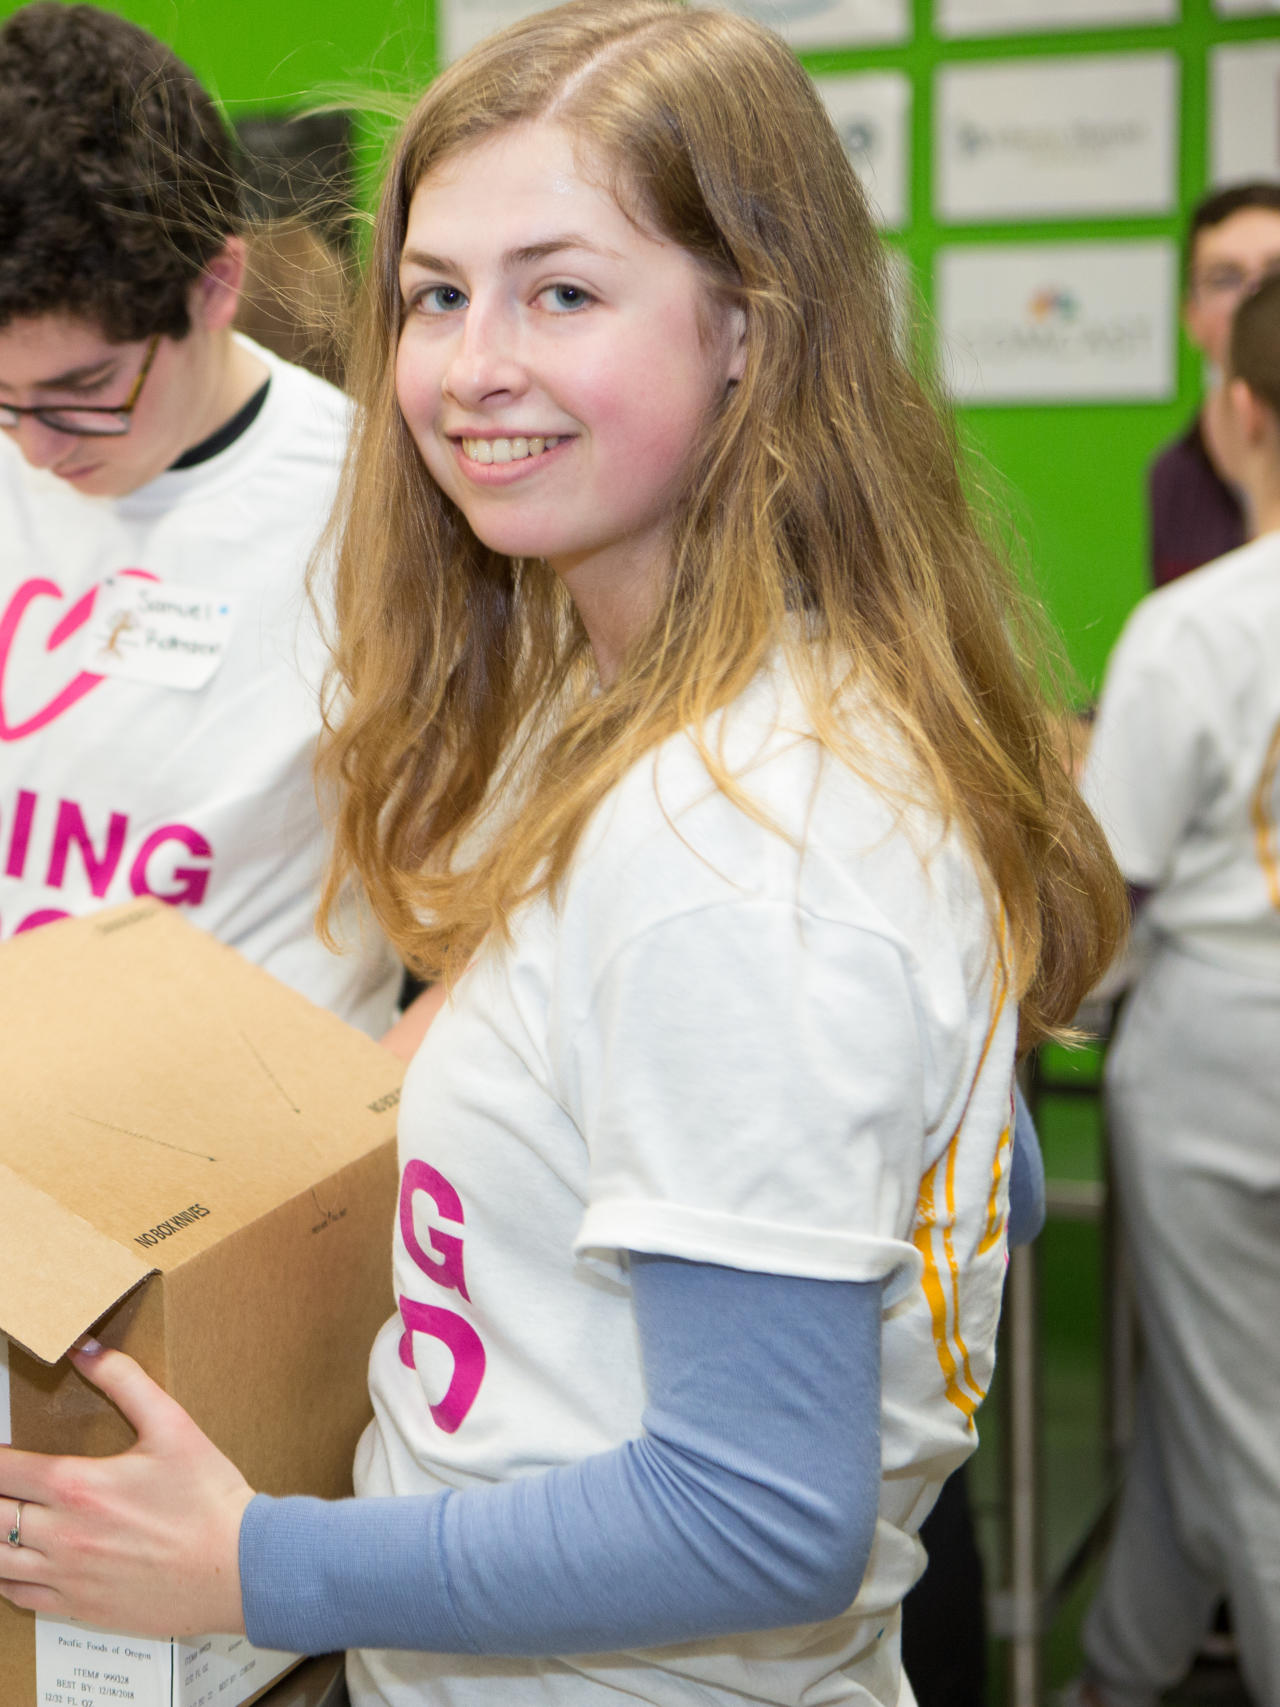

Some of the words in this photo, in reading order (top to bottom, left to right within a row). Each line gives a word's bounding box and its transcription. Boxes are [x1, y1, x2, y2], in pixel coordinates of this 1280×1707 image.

[133, 1233, 158, 1249] NO
[149, 1220, 180, 1240] BOX
[171, 1203, 210, 1229] KNIVES
[58, 1636, 82, 1648] Pacific
[86, 1641, 108, 1653] Foods
[111, 1646, 120, 1655] of
[124, 1648, 151, 1661] Oregon
[73, 1667, 100, 1680] ITEM#
[56, 1678, 76, 1690] BEST
[99, 1686, 135, 1700] 12/18/2018
[67, 1696, 78, 1706] FL
